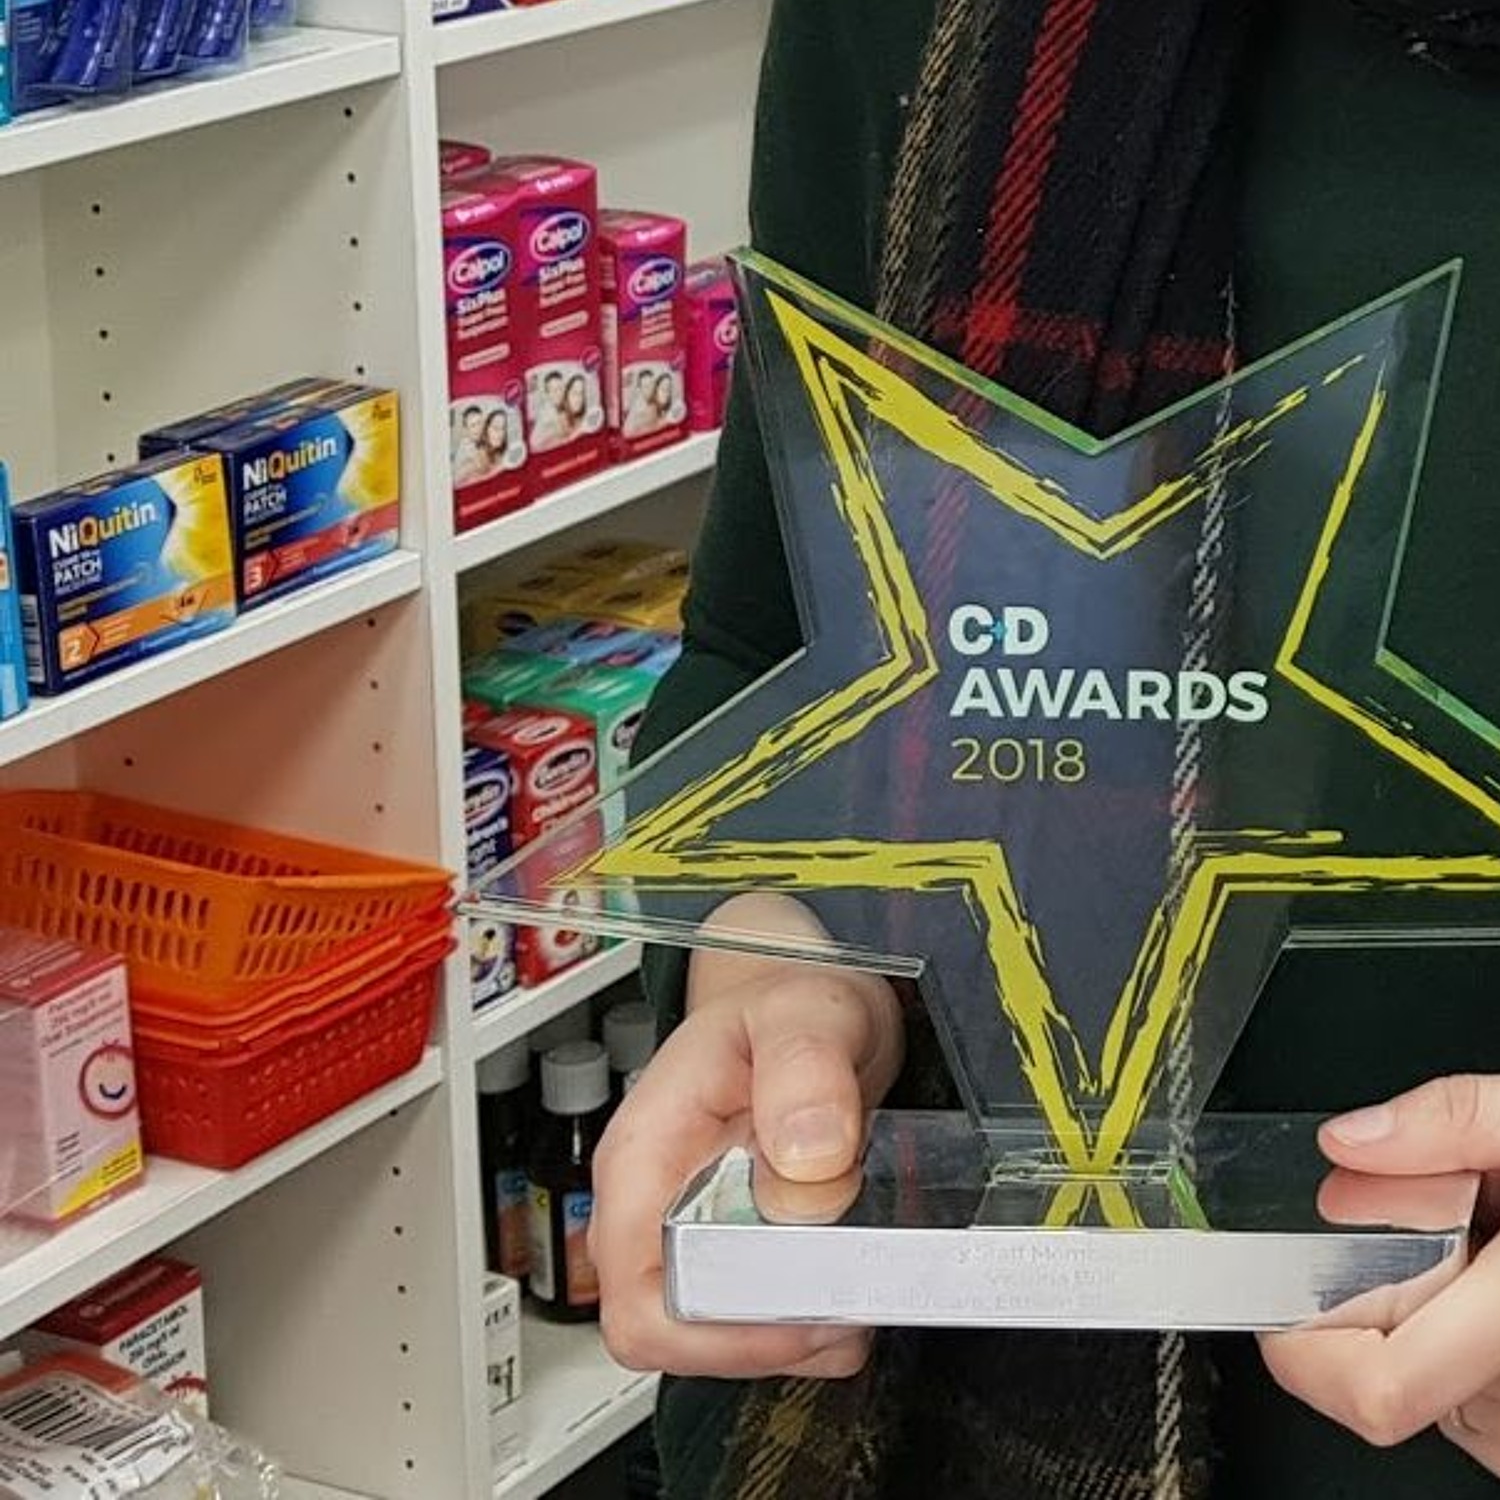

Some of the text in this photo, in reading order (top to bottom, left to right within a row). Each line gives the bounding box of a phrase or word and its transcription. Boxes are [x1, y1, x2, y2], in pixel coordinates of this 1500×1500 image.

[537, 222, 584, 254] Calpol
[455, 250, 505, 284] Calpol
[635, 267, 676, 296] Calpol
[242, 435, 338, 491] NiQuitin
[244, 487, 287, 515] PATCH
[48, 500, 158, 560] NiQuitin
[53, 558, 102, 585] PATCH
[64, 640, 81, 663] 2
[949, 667, 1269, 722] AWARDS
[951, 738, 1086, 782] 2018
